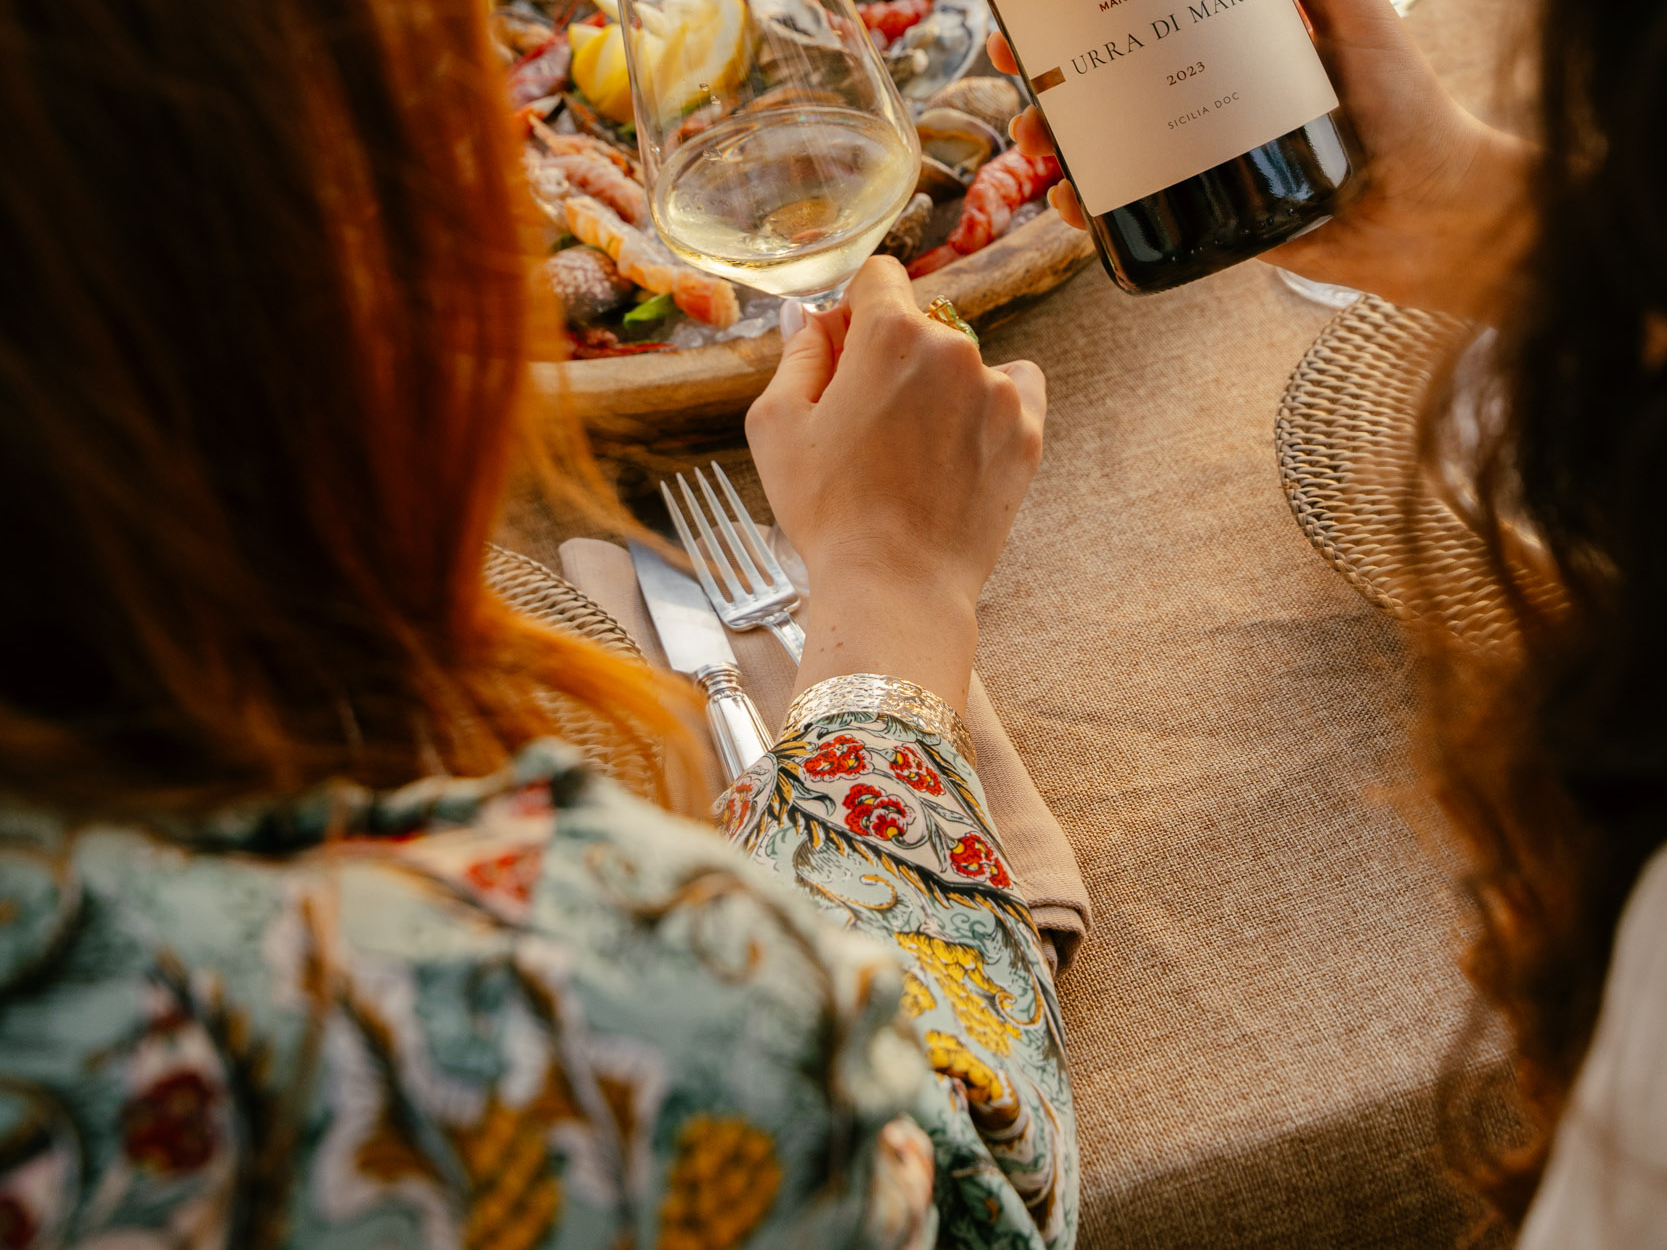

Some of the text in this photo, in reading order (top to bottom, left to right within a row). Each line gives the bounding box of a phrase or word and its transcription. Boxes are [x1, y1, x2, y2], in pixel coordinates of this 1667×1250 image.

[1070, 33, 1146, 75] URRA
[1150, 13, 1182, 41] DI
[1166, 61, 1207, 87] 2023
[1167, 91, 1241, 130] SICILIA DOC
